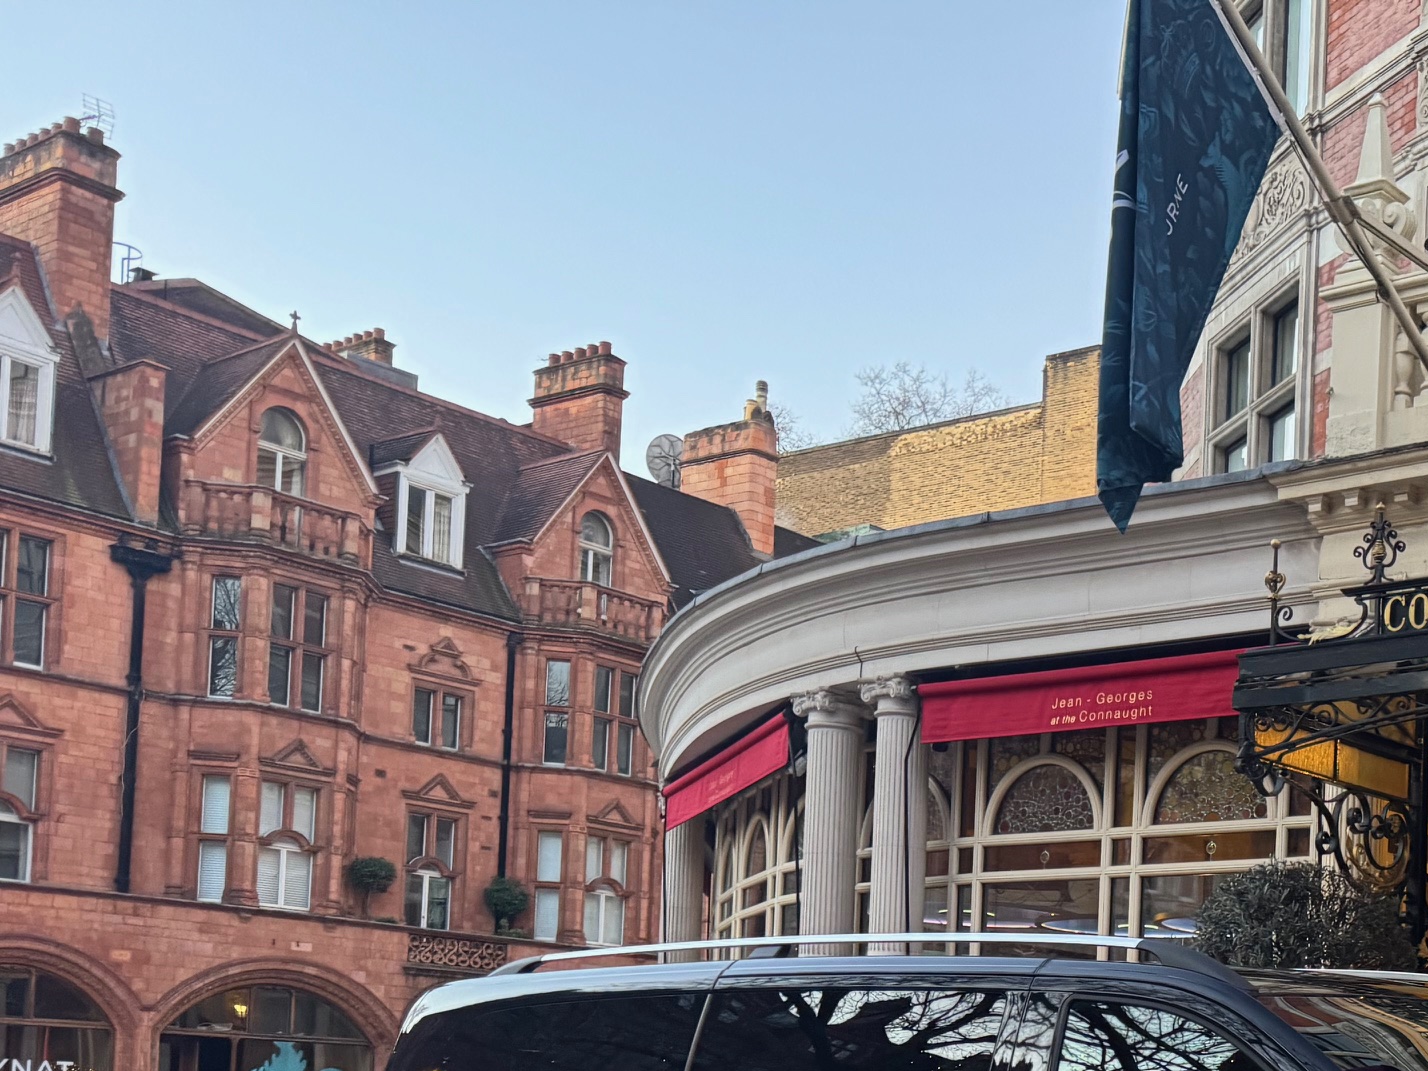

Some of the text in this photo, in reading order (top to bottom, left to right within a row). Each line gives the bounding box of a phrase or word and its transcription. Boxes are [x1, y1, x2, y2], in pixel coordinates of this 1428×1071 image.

[1051, 697, 1082, 709] Jean
[1096, 690, 1153, 705] Georges
[1050, 705, 1153, 726] at the Connaught
